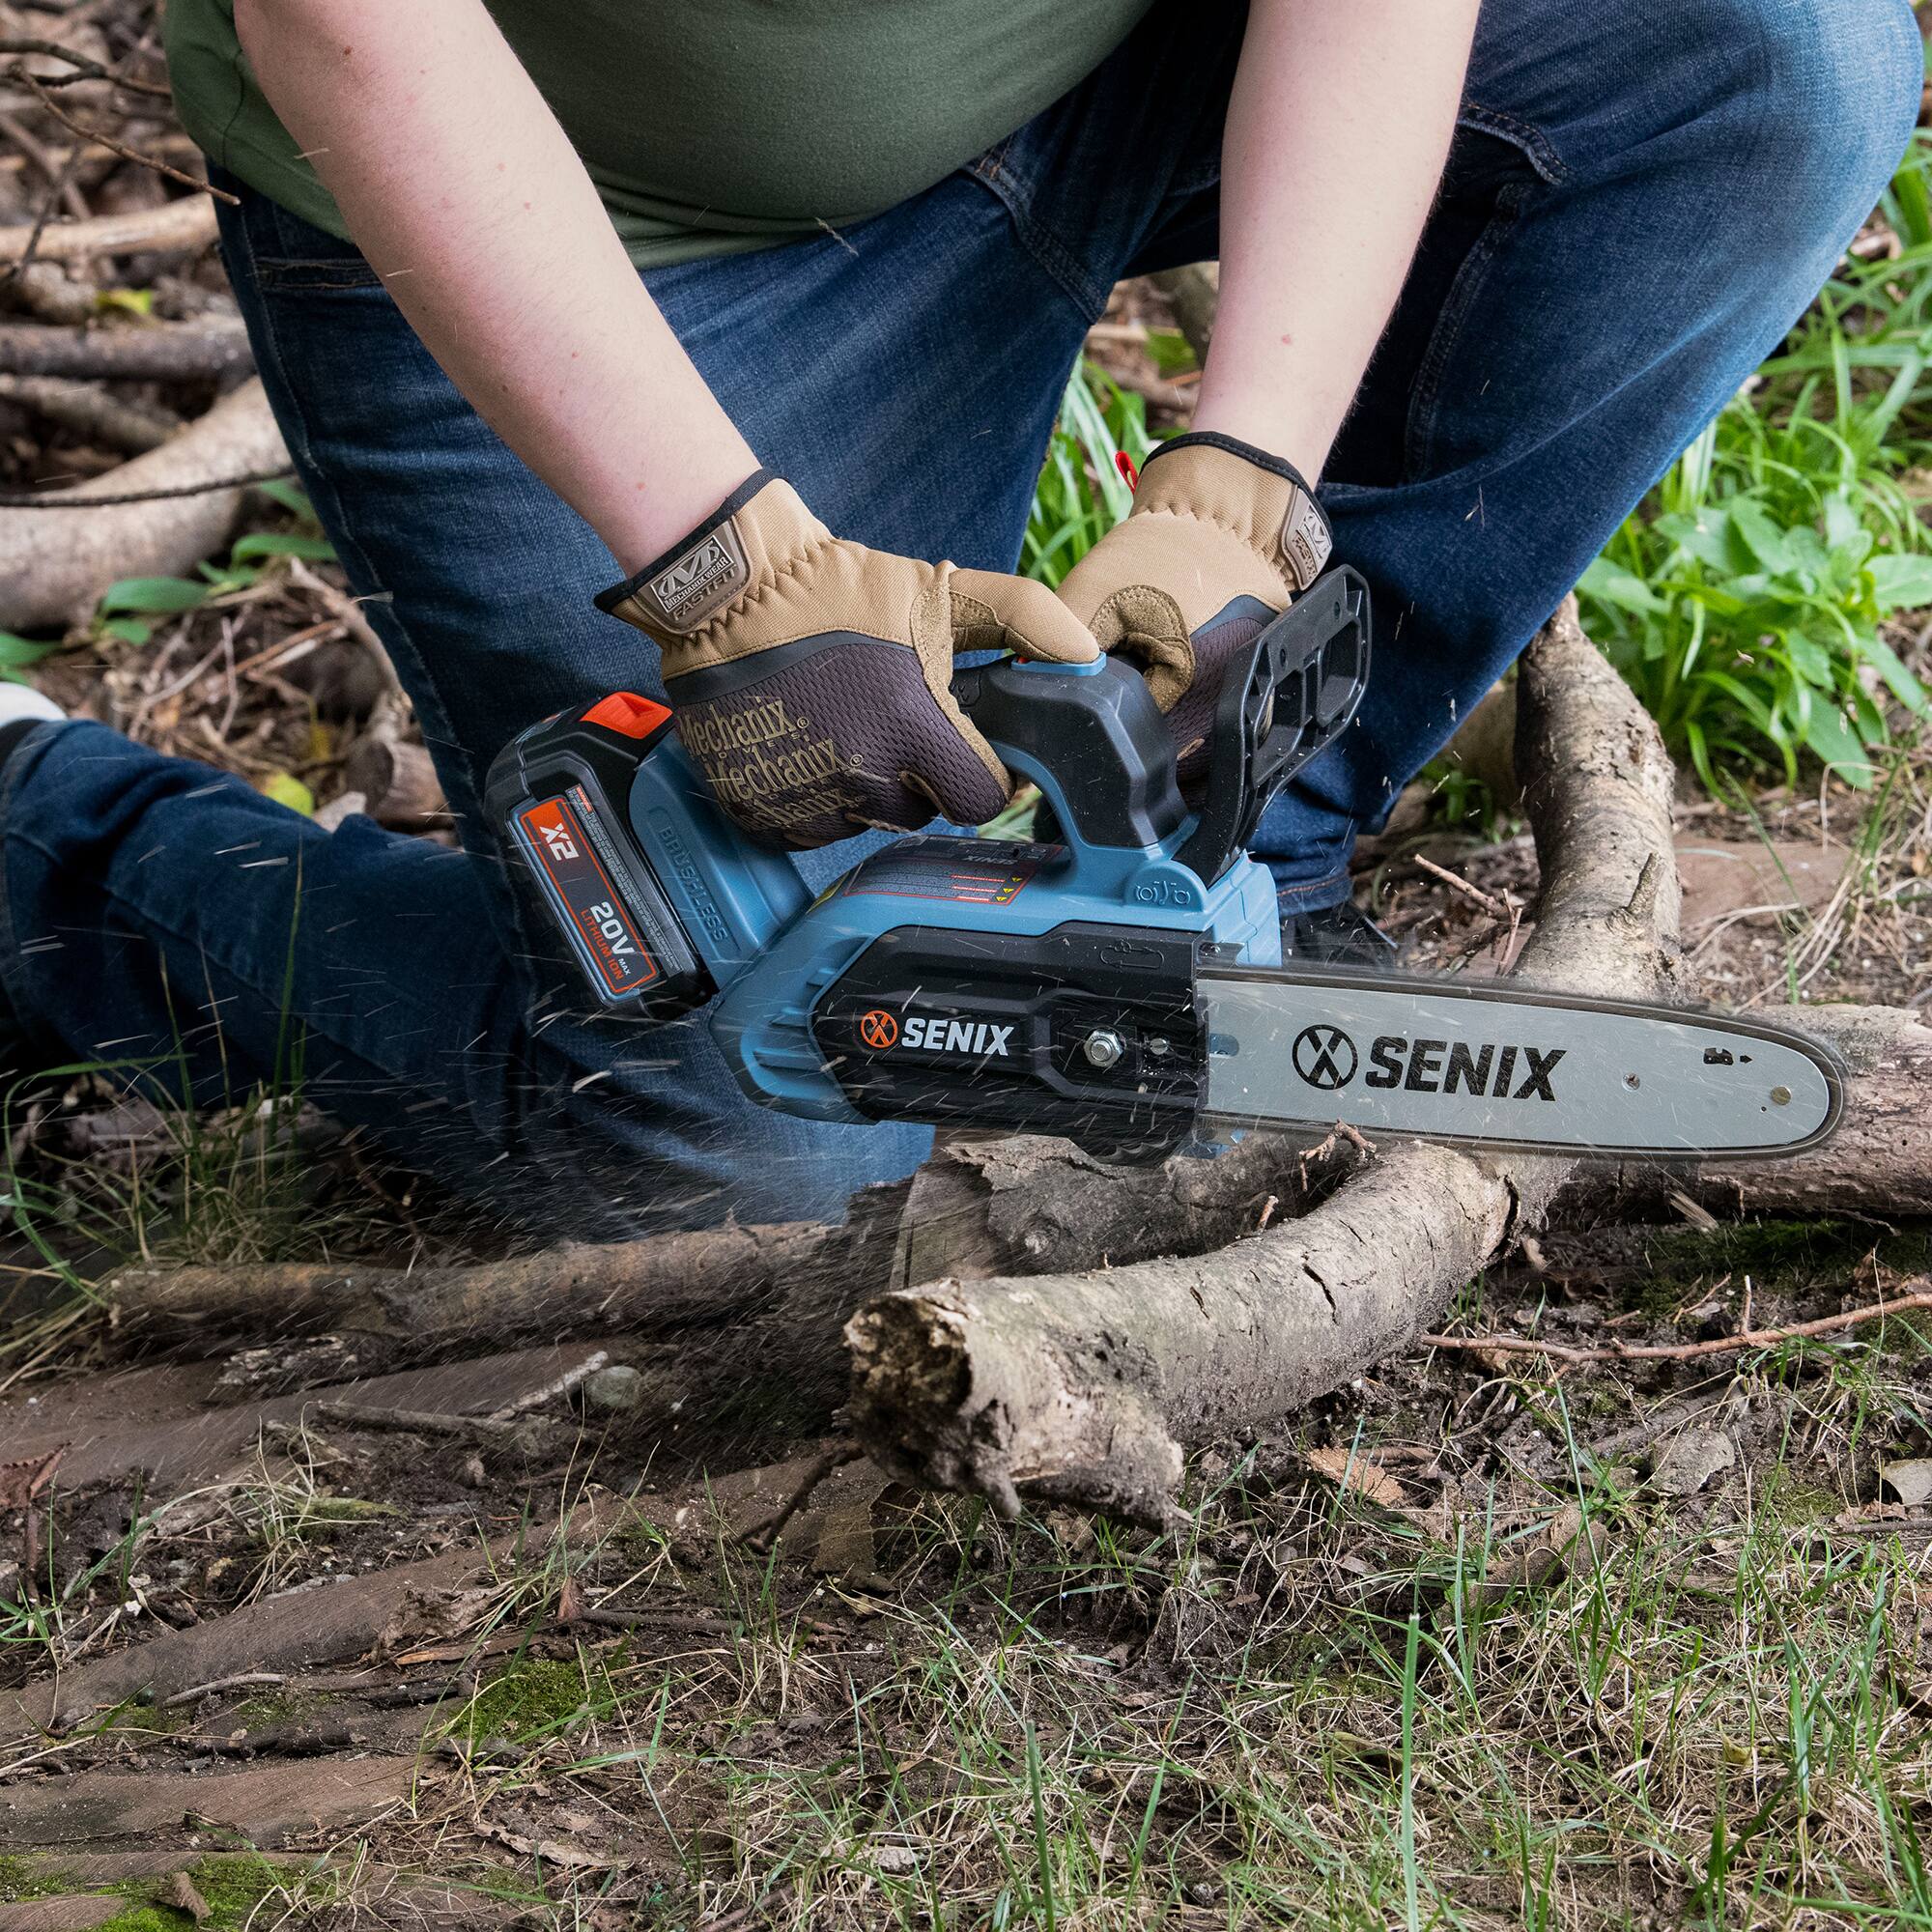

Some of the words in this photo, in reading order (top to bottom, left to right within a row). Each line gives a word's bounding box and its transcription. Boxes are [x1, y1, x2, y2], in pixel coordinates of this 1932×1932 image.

[672, 563, 738, 621] FASTFIT
[539, 822, 580, 862] X2
[659, 826, 728, 941] BRUSHLESS
[581, 908, 612, 959] LITHIUM
[607, 957, 625, 980] ION
[590, 901, 636, 955] 20V
[617, 957, 632, 976] MAX
[901, 1017, 1014, 1057] SENIX
[1365, 1036, 1568, 1102] SENIX
